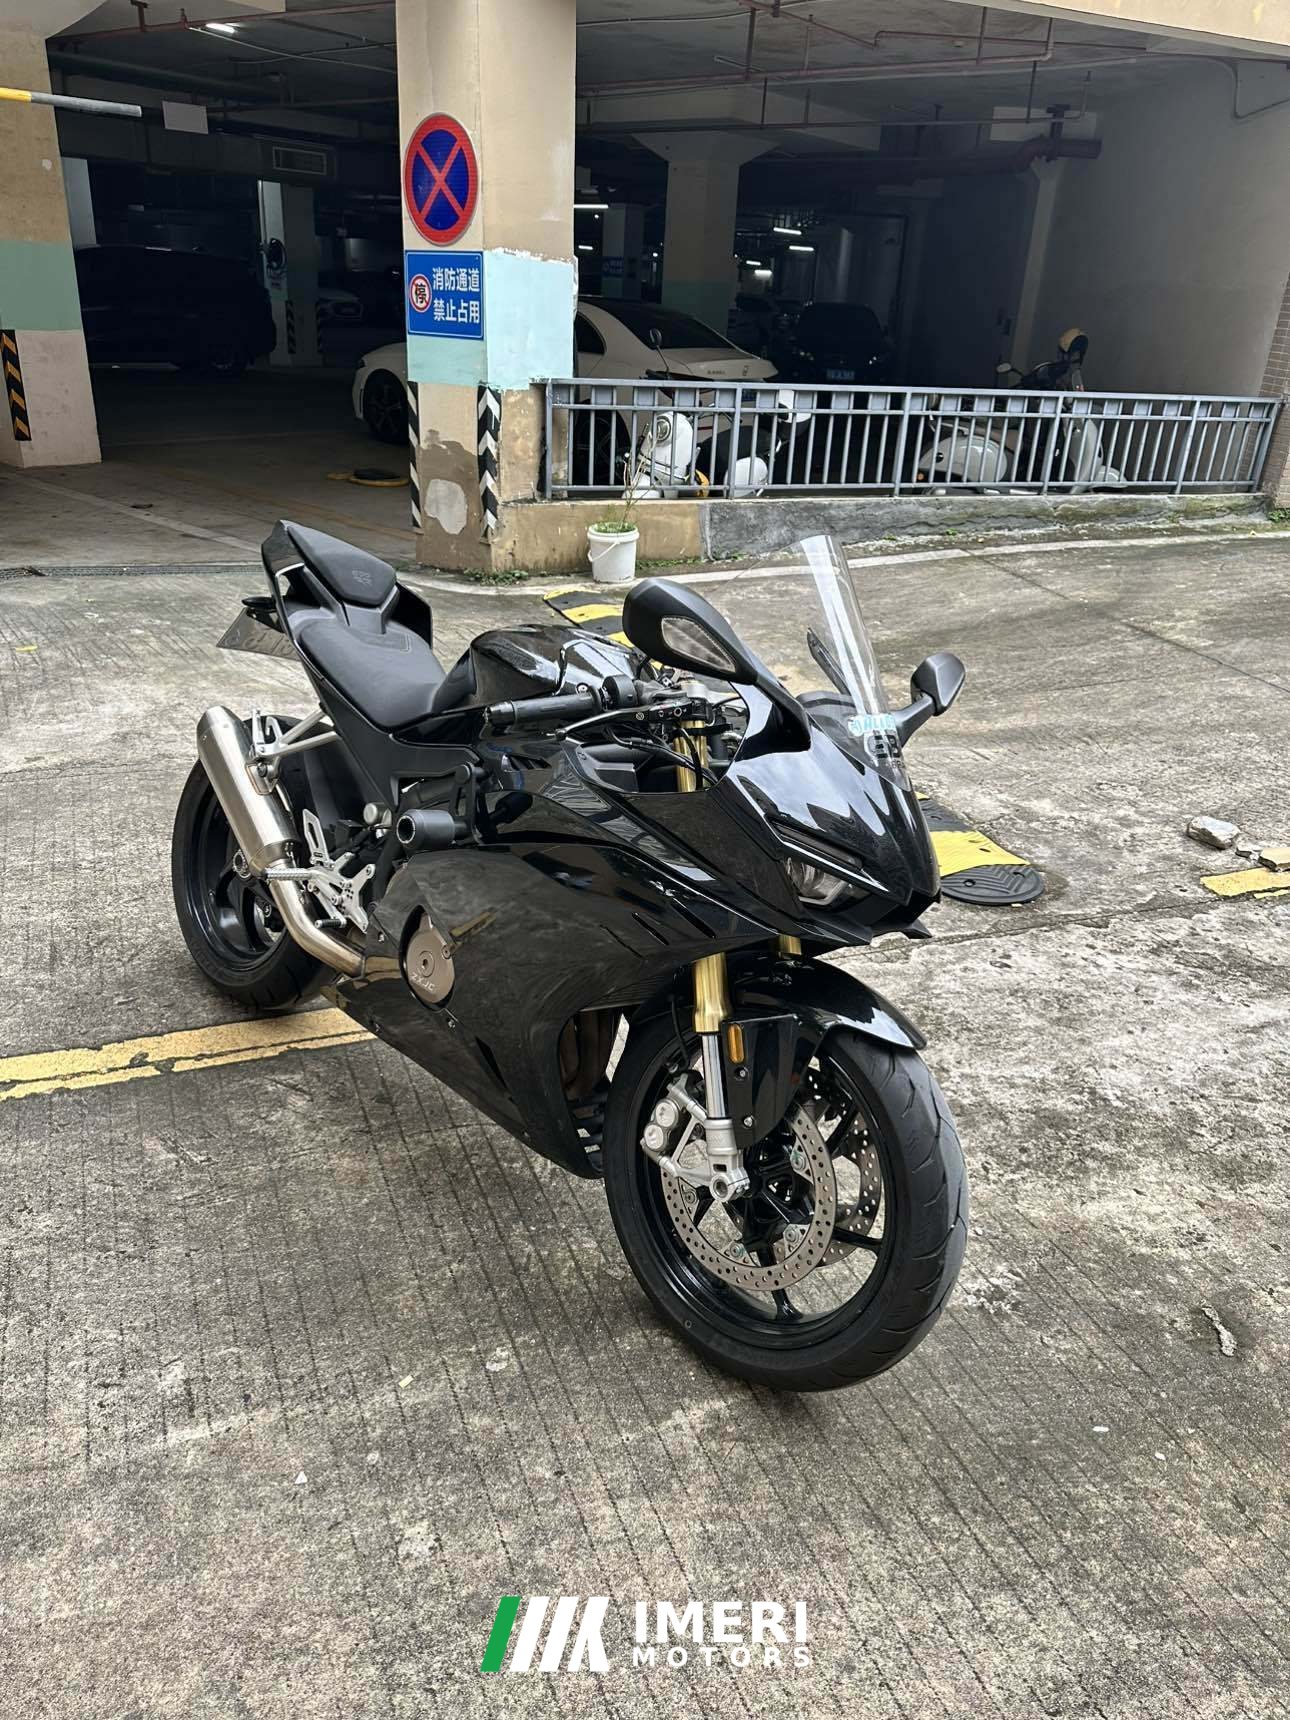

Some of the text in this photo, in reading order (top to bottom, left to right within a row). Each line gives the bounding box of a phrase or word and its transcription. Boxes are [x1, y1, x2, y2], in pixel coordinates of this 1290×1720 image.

[432, 267, 480, 292] 消防通道
[414, 283, 427, 304] 停
[433, 298, 480, 324] 禁止占用
